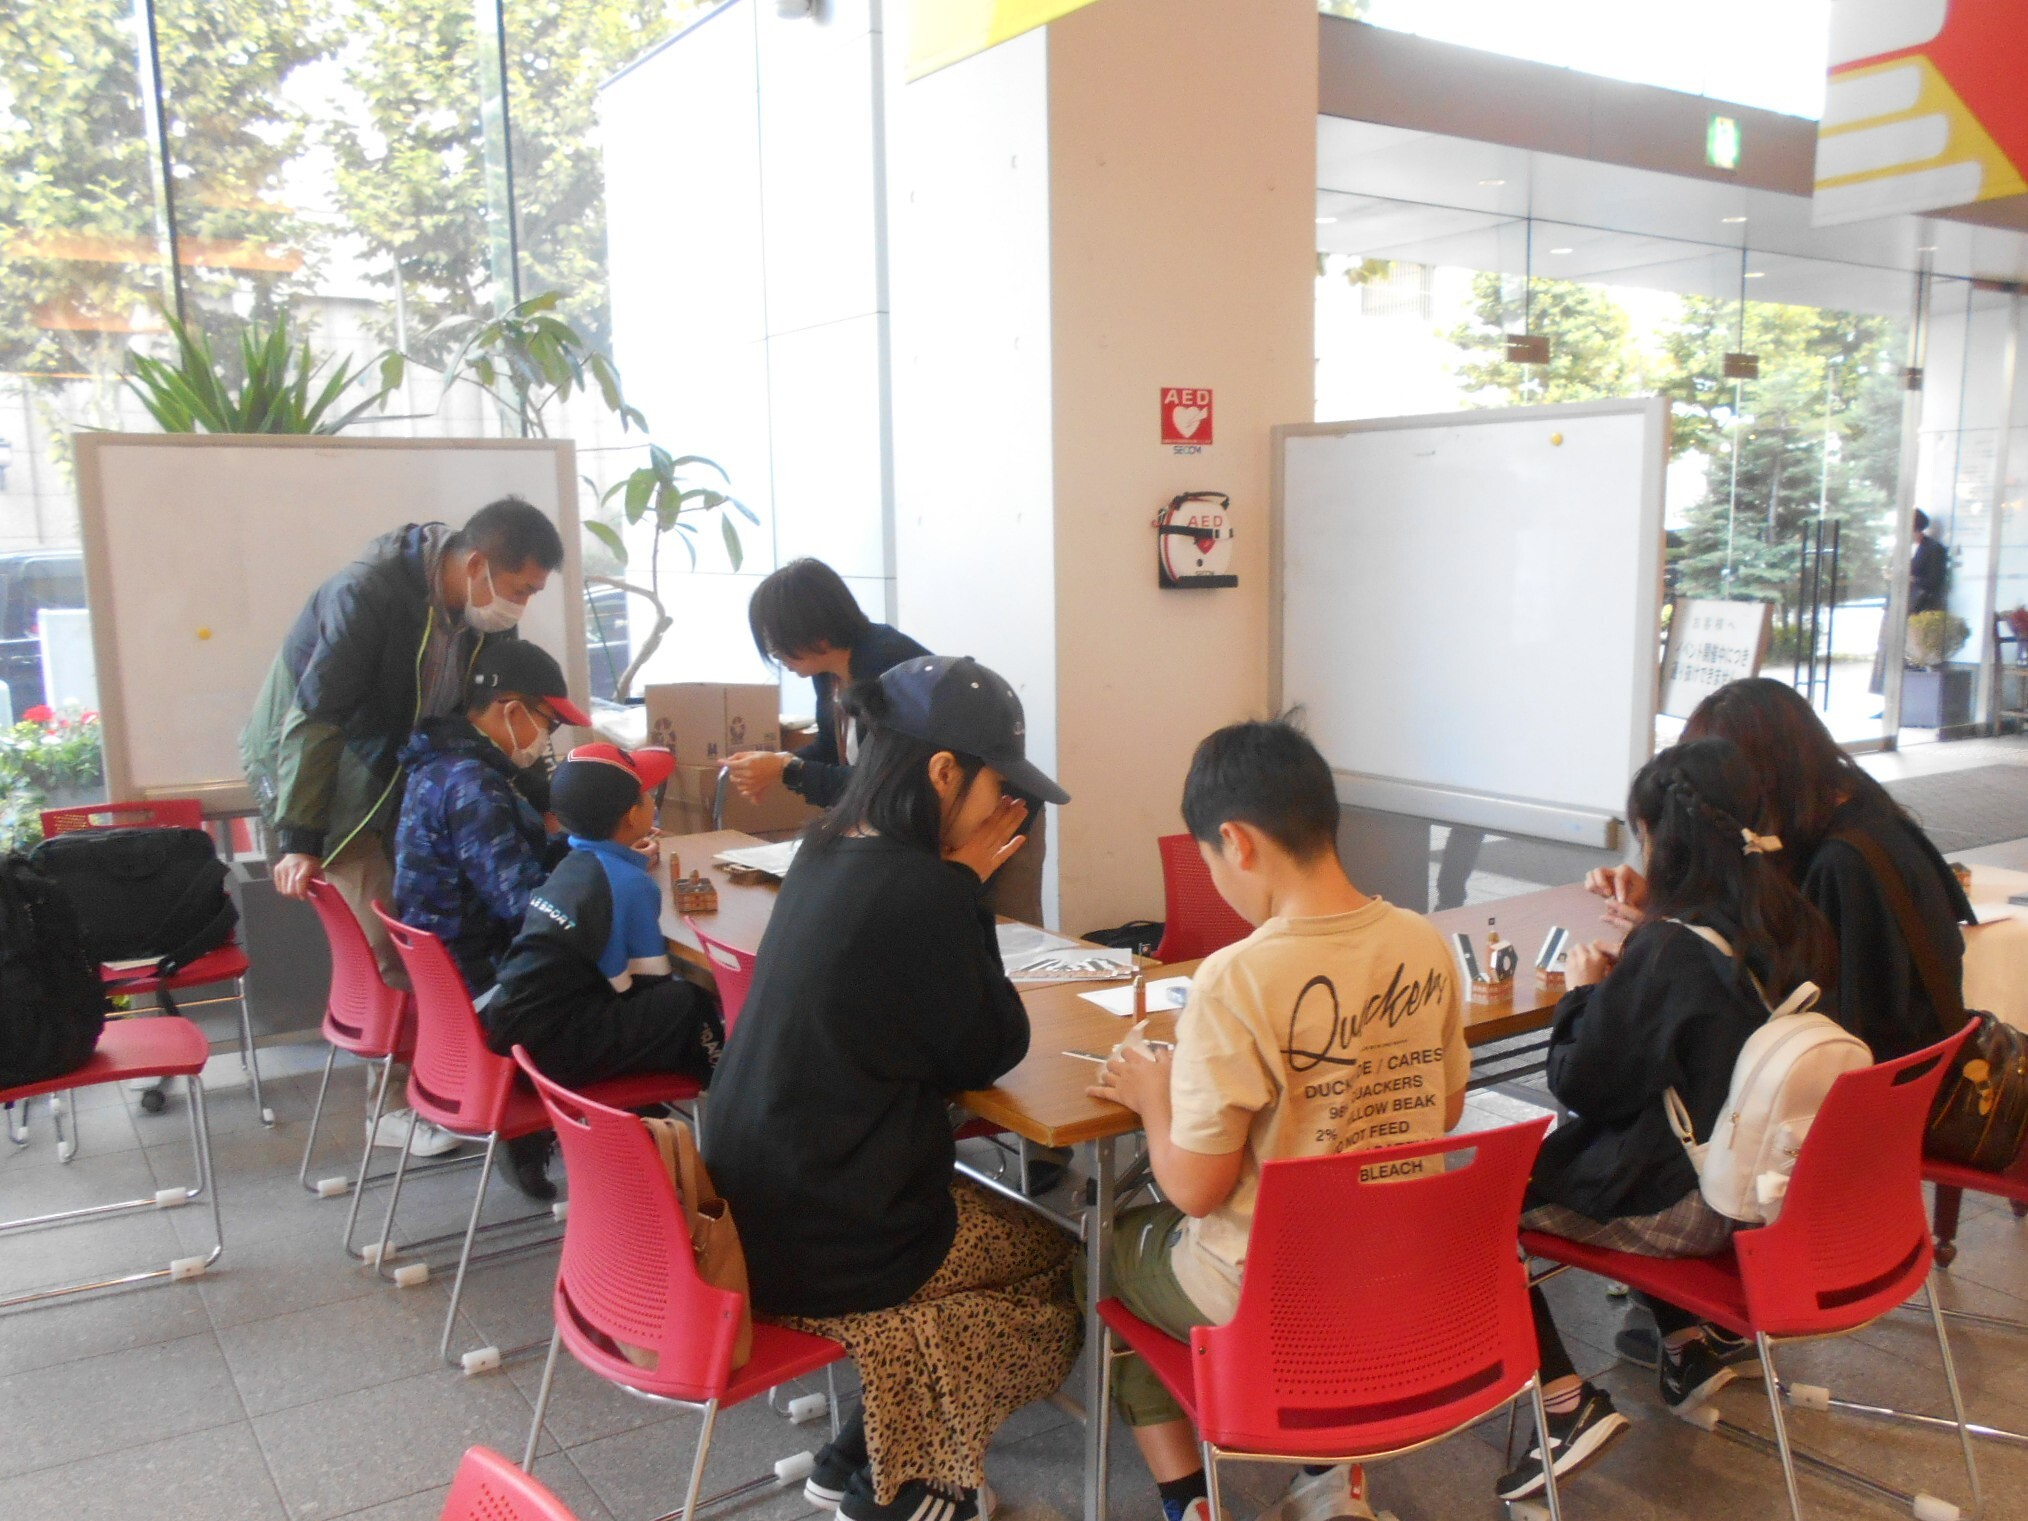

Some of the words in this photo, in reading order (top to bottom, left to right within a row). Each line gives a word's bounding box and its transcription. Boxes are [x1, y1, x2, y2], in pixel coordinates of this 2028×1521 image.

[1164, 389, 1210, 405] AED
[1187, 515, 1223, 528] AED
[1387, 1047, 1444, 1070] CARES
[1392, 1094, 1436, 1112] BEAK
[1369, 1120, 1410, 1138] FEED
[1360, 1160, 1424, 1182] BLEACH
